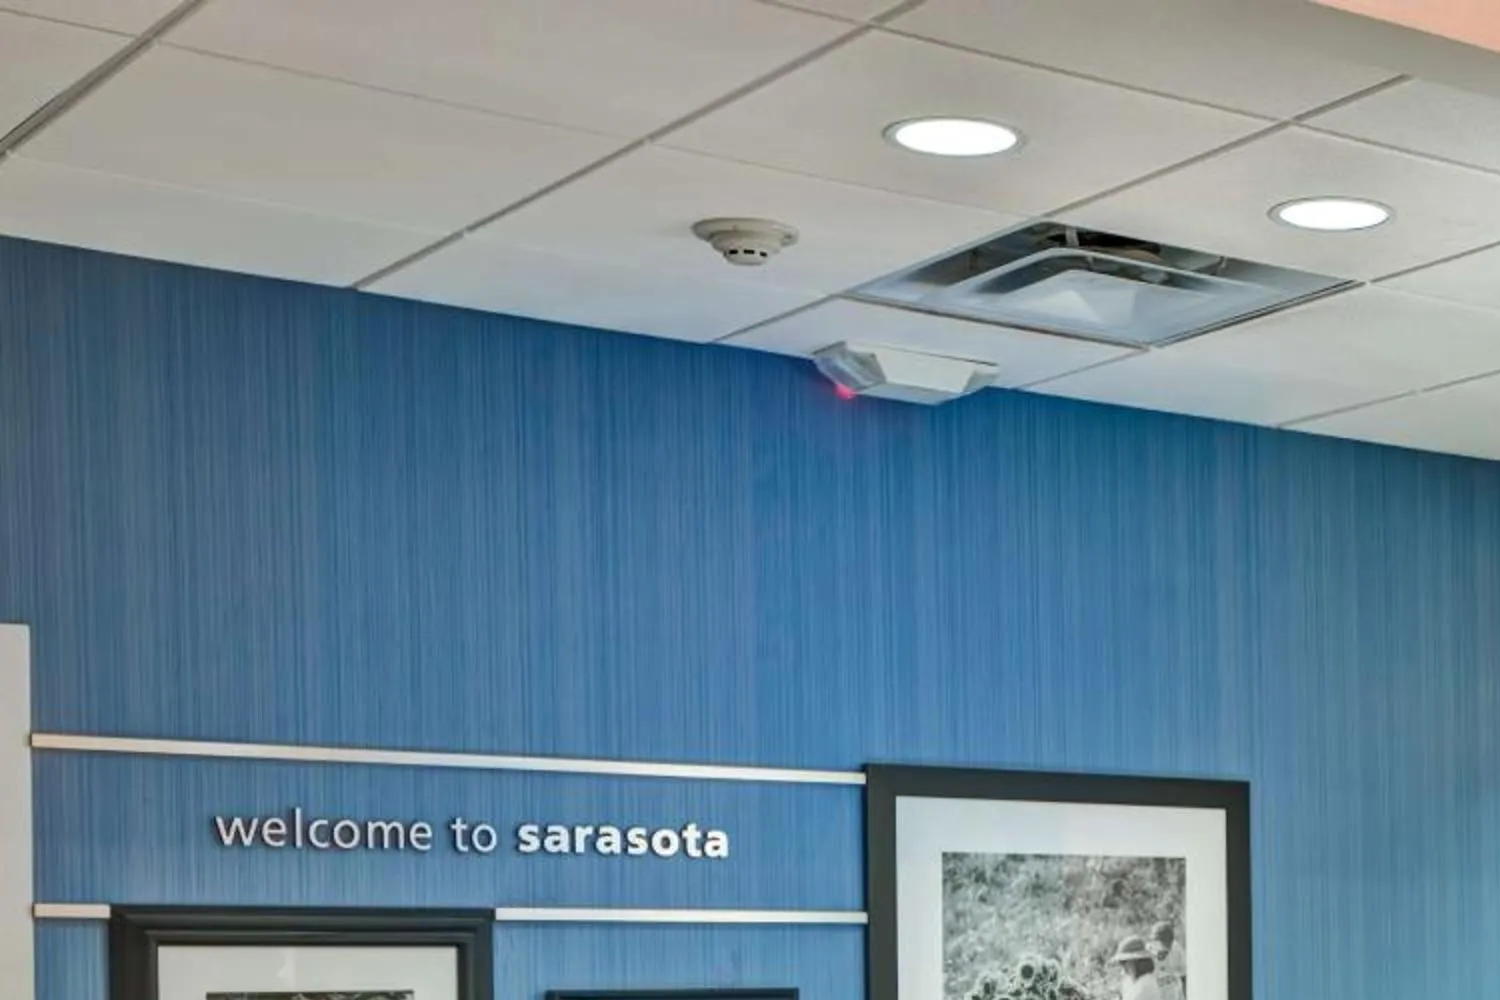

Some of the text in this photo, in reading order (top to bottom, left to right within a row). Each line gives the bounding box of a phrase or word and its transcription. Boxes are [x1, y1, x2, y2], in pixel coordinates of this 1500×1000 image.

[214, 807, 731, 859] welcome to sarasota
